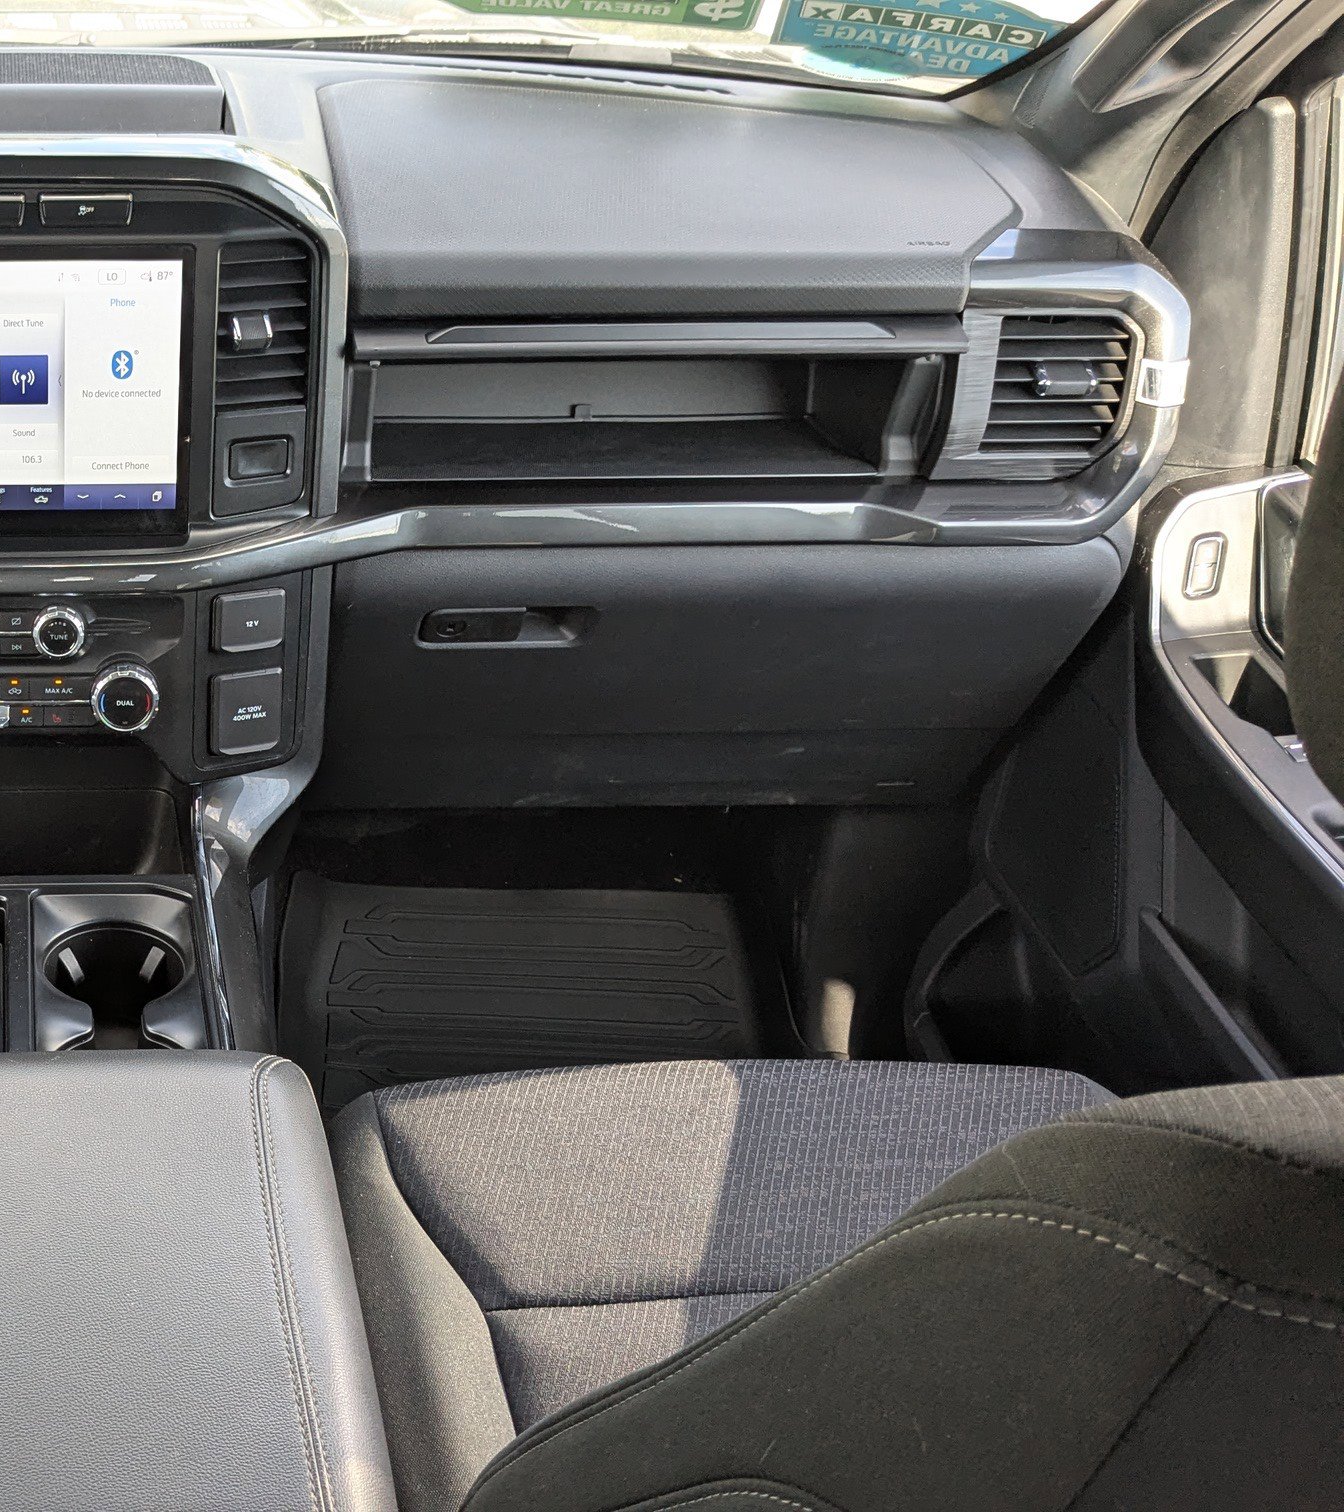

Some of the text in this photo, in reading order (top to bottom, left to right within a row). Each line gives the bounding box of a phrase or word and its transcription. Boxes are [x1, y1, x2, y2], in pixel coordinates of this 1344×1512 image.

[106, 273, 118, 282] LO
[156, 271, 174, 281] 87°
[110, 298, 136, 307] Phone
[3, 319, 44, 328] Direct Tune
[82, 390, 162, 398] No device connected
[12, 428, 36, 437] Sound
[22, 456, 42, 464] 106.3
[92, 461, 150, 470] Connect Phone
